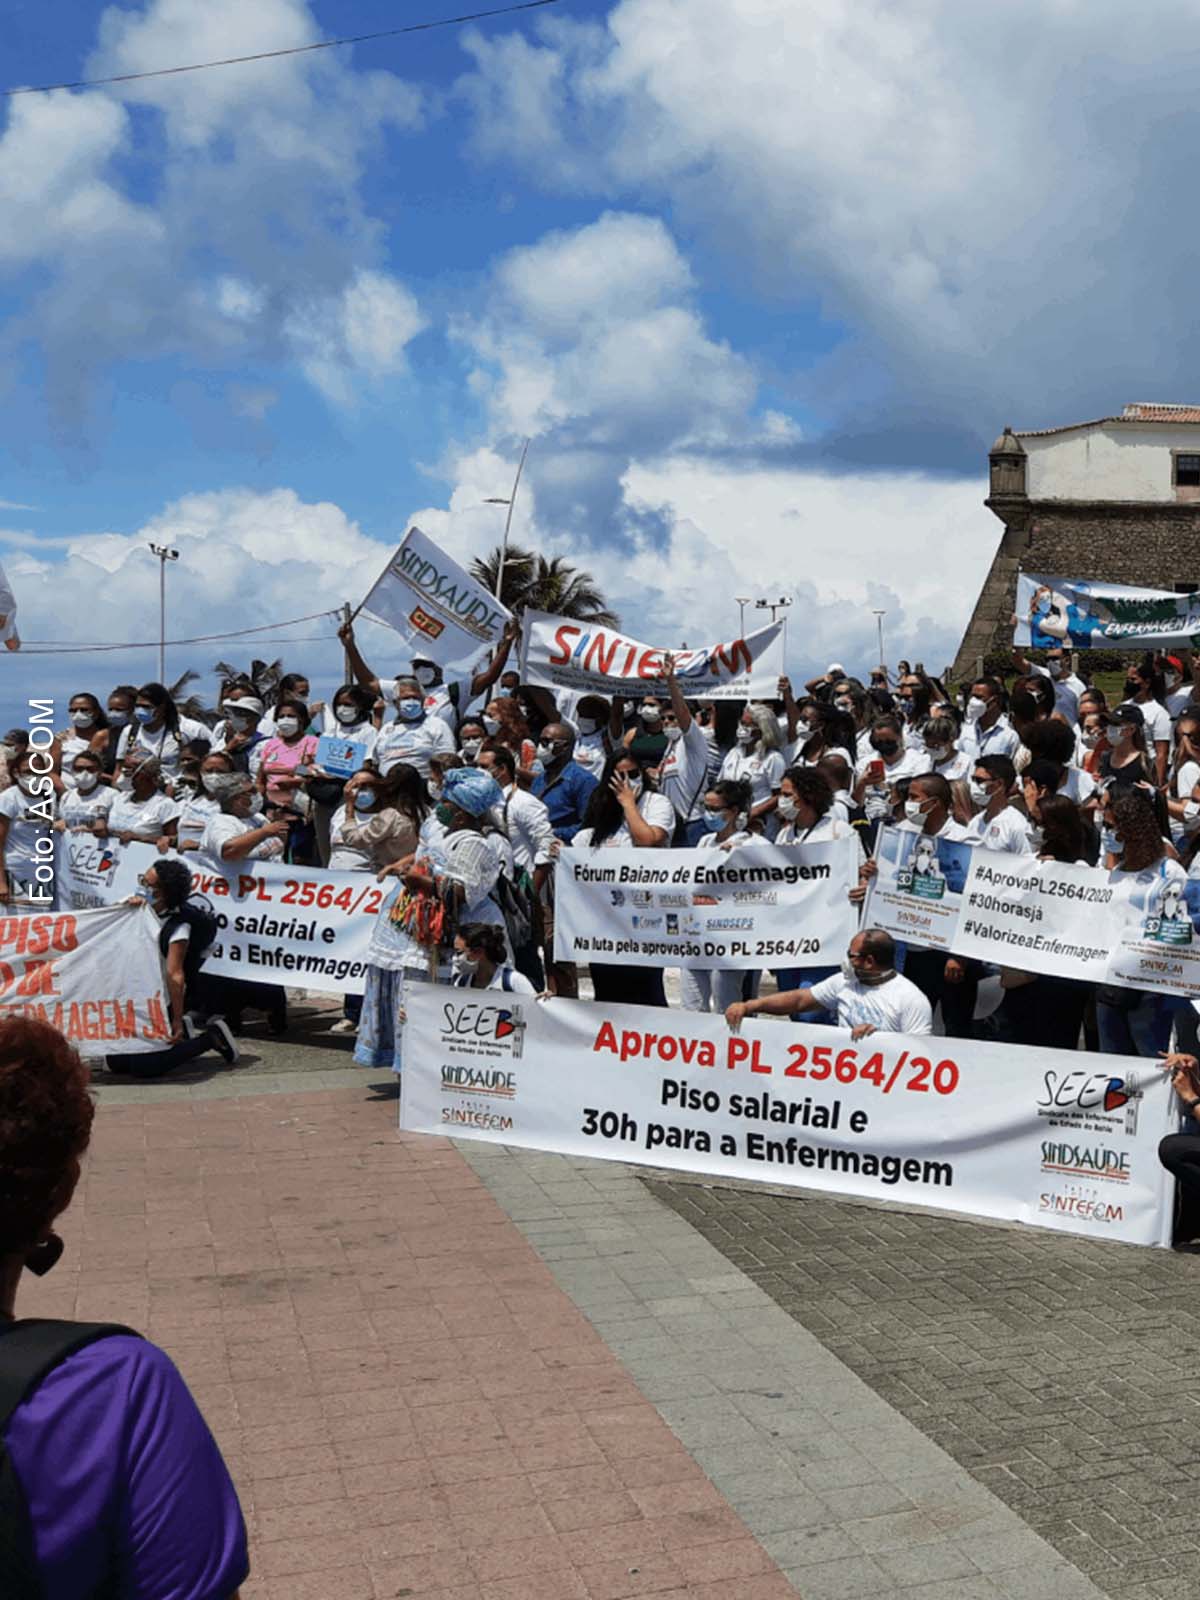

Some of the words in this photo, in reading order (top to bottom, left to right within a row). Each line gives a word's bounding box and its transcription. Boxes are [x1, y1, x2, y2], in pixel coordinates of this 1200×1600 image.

[574, 864, 615, 882] Fórum
[619, 866, 668, 884] Baiano
[672, 866, 690, 884] de
[694, 863, 830, 885] Enfermagem
[975, 865, 1114, 904] #AprovaPL2564/2020
[238, 875, 272, 901] PL
[280, 880, 382, 916] 2564/2
[968, 892, 1043, 923] #30horasjá
[234, 914, 317, 941] salarial
[321, 926, 336, 944] e
[574, 937, 590, 950] Na
[592, 937, 614, 951] luta
[615, 939, 639, 954] pela
[642, 940, 700, 958] aprovação
[705, 943, 726, 956] Do
[731, 942, 751, 956] PL
[756, 938, 820, 957] 2564/20
[964, 919, 1110, 962] #ValorizeaEnfermagem
[230, 944, 242, 961] a
[440, 1002, 516, 1040] SEEB
[440, 1064, 517, 1089] SINDSAÚDE
[593, 1021, 716, 1067] Aprova
[726, 1036, 773, 1074] PL
[784, 1044, 960, 1095] 2564/20
[661, 1079, 720, 1112] Piso
[729, 1092, 841, 1130] salarial
[849, 1109, 869, 1133] e
[1036, 1070, 1129, 1112] SEEB
[581, 1108, 638, 1141] 30h
[646, 1122, 711, 1152] para
[720, 1134, 737, 1156] a
[747, 1133, 953, 1186] Enfermagem
[1040, 1141, 1131, 1172] SINDSAÚDE
